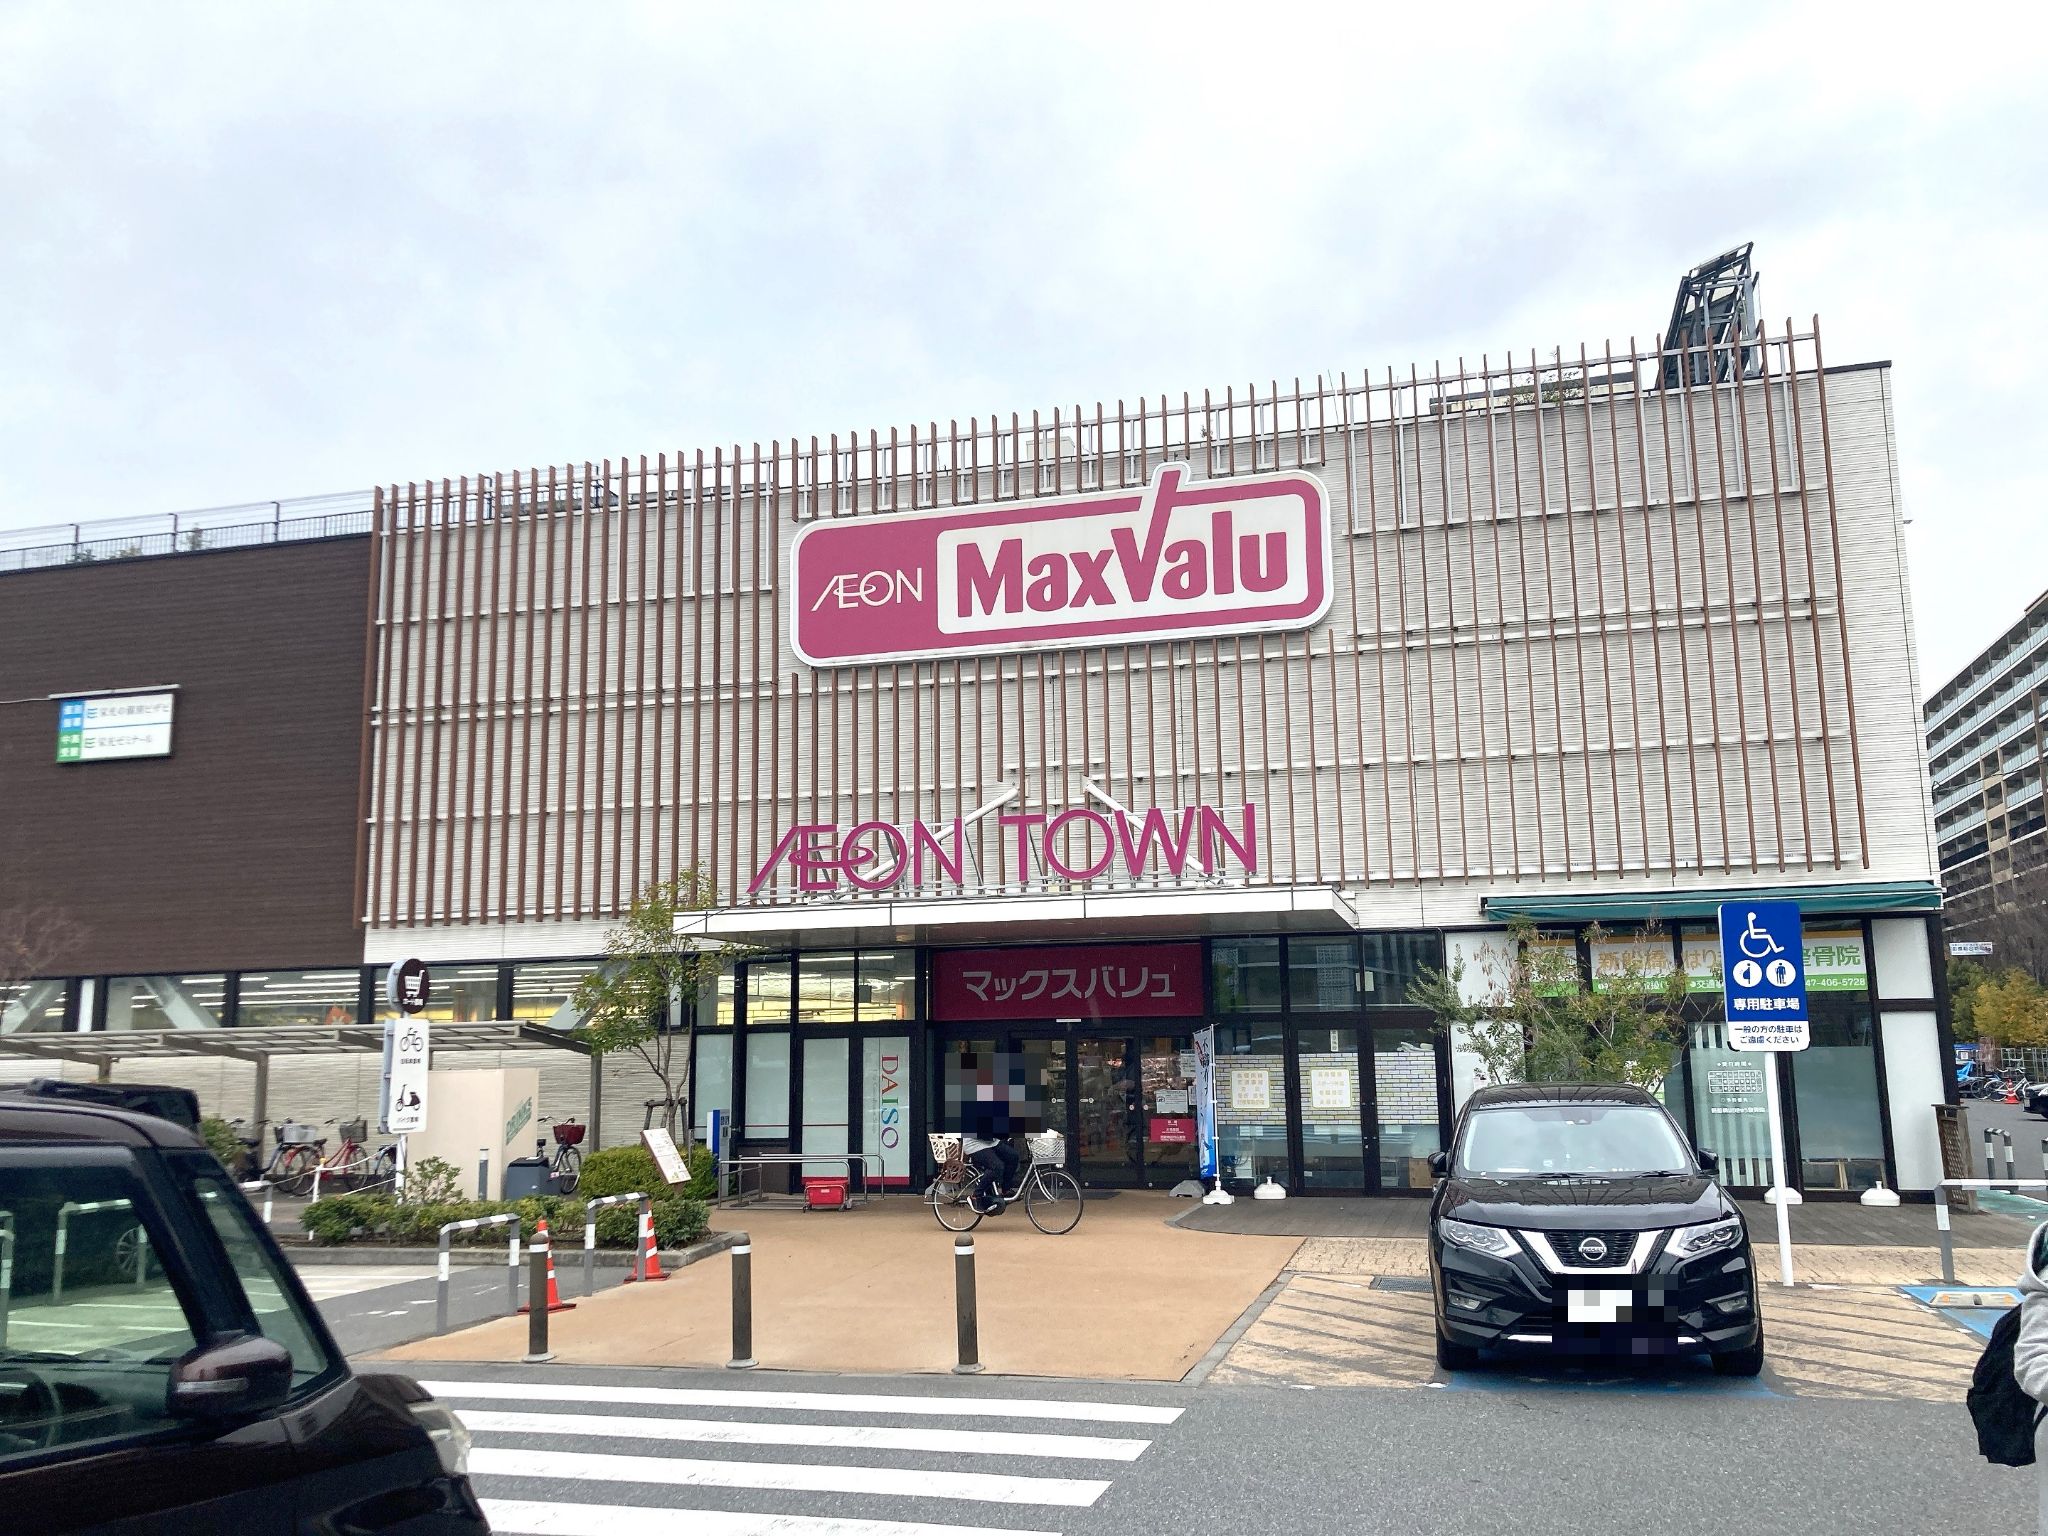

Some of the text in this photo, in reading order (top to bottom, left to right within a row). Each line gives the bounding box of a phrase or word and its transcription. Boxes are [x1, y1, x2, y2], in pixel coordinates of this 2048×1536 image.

[956, 469, 1288, 618] MaxValu
[999, 803, 1256, 882] TOWN
[963, 966, 1175, 1001] マックスバリュ
[1733, 998, 1800, 1011] 専用駐車場
[1734, 1025, 1803, 1034] 一般の方の駐車は
[1740, 1035, 1799, 1044] ご遠慮ください
[881, 1055, 899, 1149] DAISO
